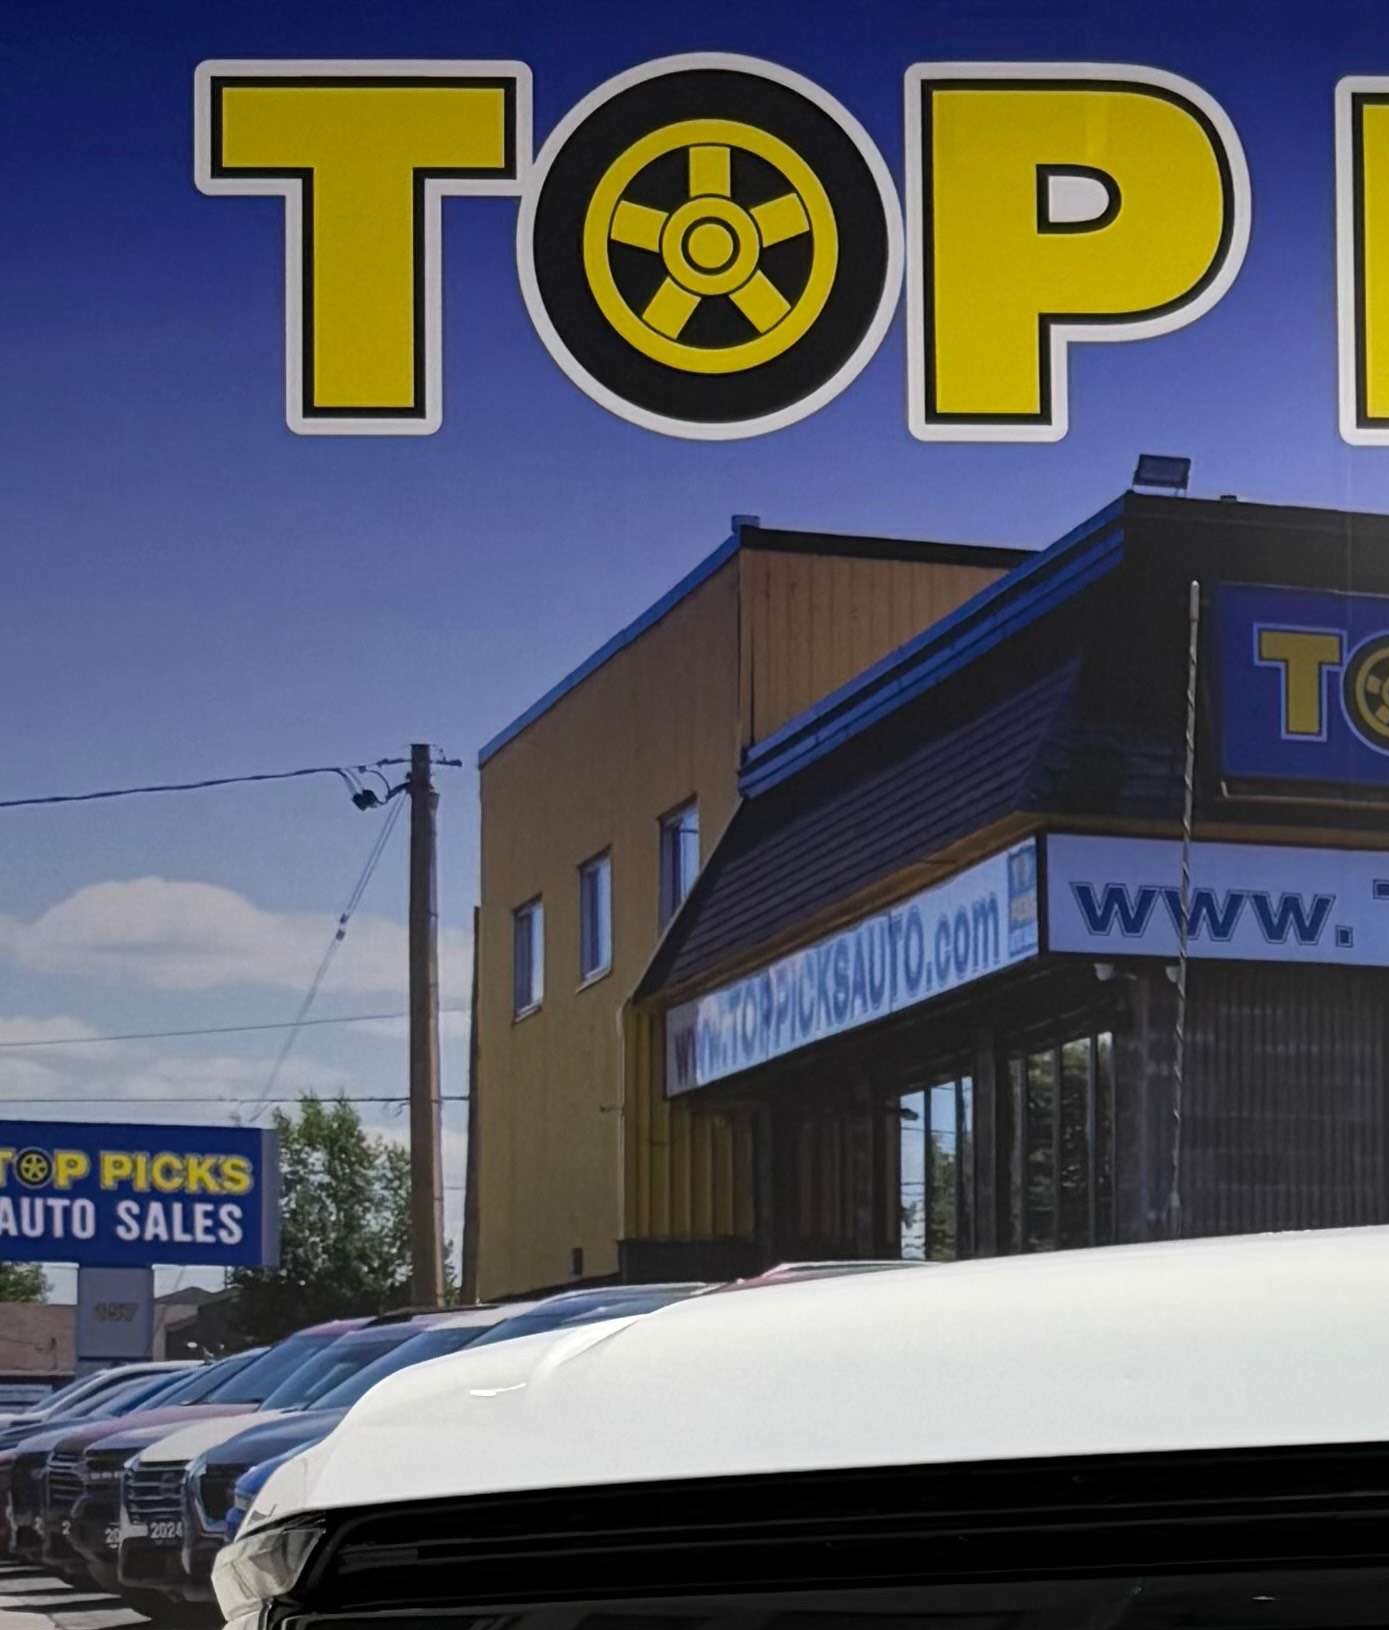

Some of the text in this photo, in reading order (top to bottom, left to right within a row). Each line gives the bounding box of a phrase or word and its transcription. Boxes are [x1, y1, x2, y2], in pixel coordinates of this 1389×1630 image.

[195, 51, 1250, 442] TOP
[100, 1150, 254, 1196] PICKS
[0, 1196, 244, 1246] AUTO SALES
